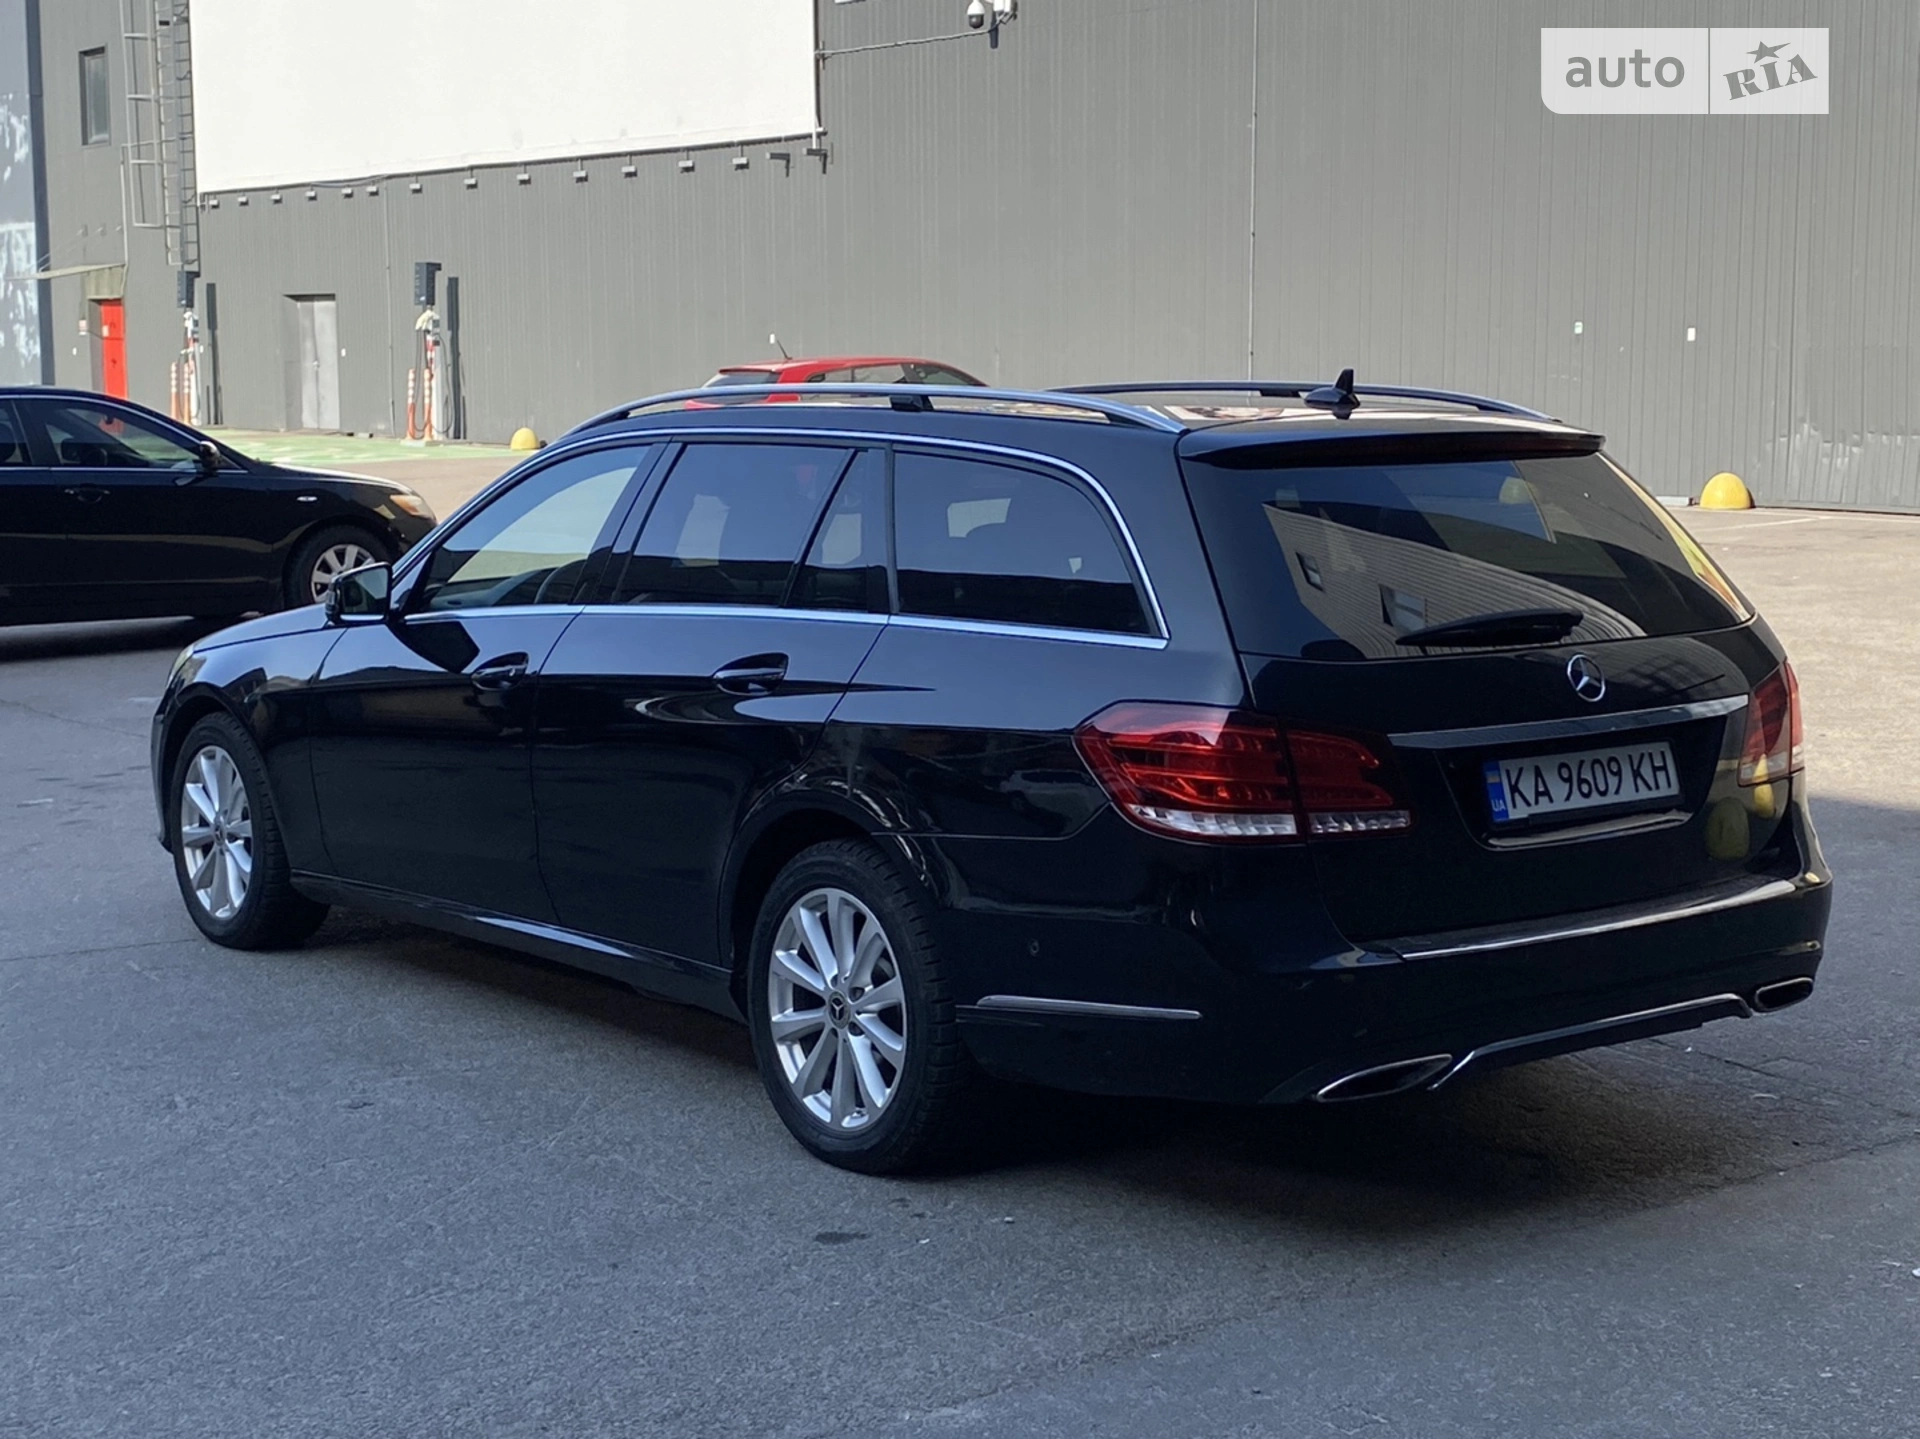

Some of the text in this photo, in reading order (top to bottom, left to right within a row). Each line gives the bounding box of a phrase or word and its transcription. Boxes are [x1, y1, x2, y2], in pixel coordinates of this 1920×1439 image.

[1505, 750, 1672, 809] KA 9609 KH
[1491, 799, 1506, 811] UA
